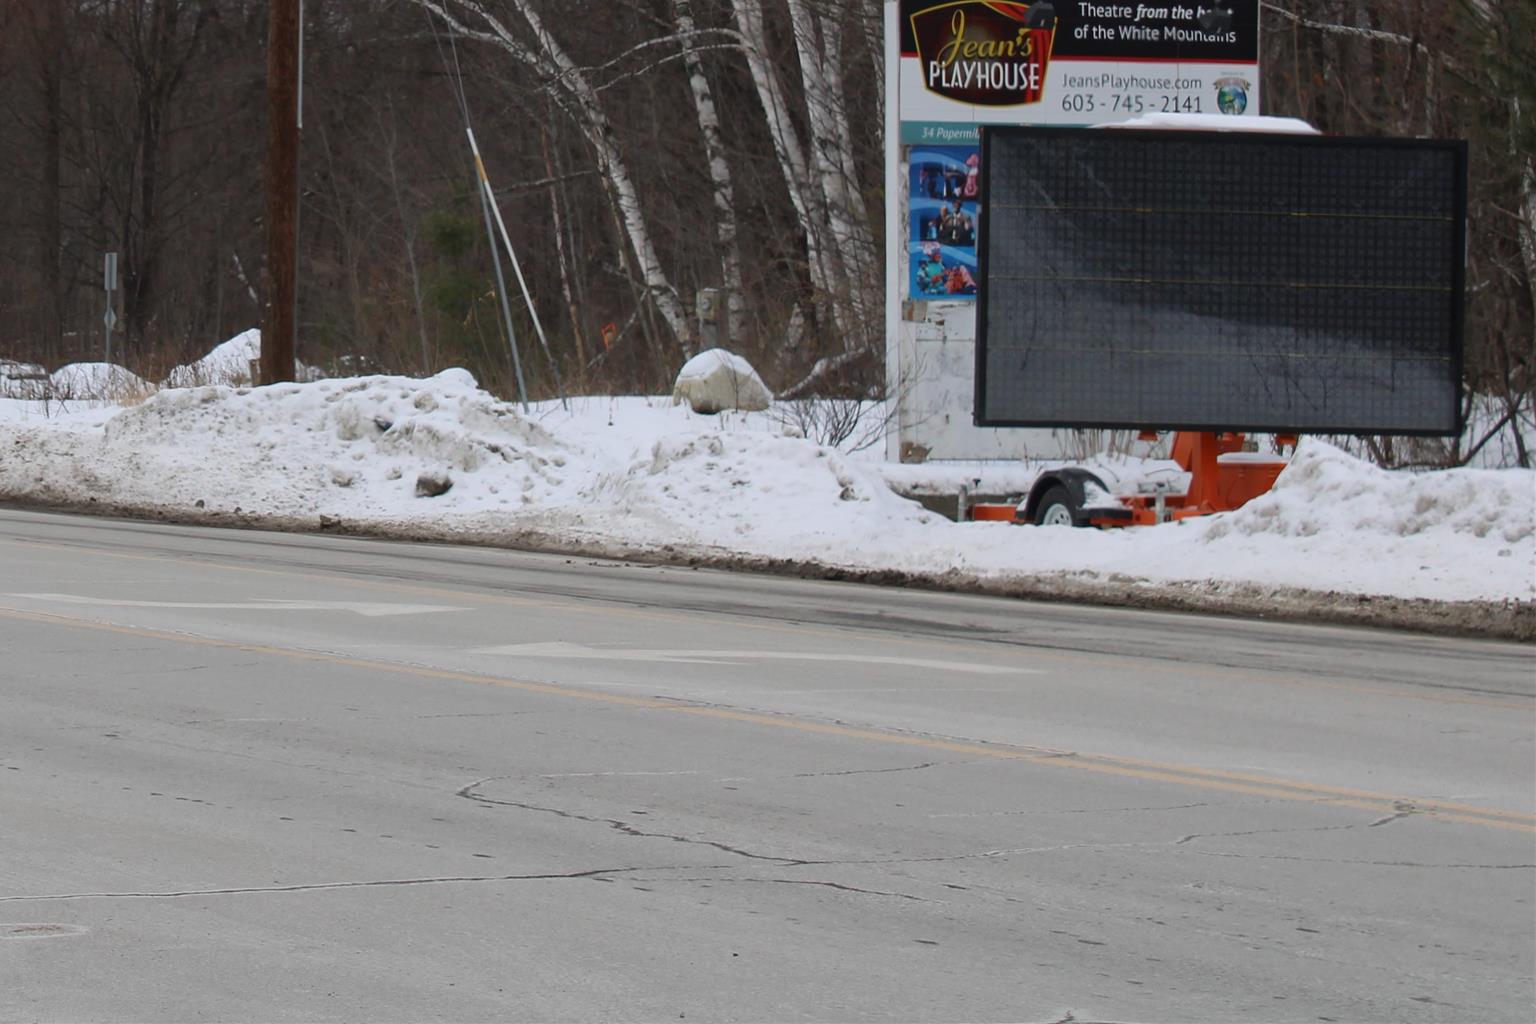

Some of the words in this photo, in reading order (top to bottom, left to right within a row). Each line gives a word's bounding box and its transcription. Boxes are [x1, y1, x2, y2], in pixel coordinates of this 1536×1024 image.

[1078, 2, 1132, 18] Theatre
[1134, 4, 1168, 22] from
[1171, 5, 1193, 20] the
[937, 9, 1033, 68] Jean's
[1074, 25, 1089, 39] of
[1092, 25, 1115, 40] the
[1118, 25, 1160, 40] White
[929, 60, 1039, 90] PLAYHOUSE
[1062, 73, 1202, 91] JeansPlayhouse.com
[1061, 94, 1094, 112] 603
[1111, 94, 1144, 112] 745
[1161, 95, 1203, 114] 2141
[922, 127, 935, 138] 34
